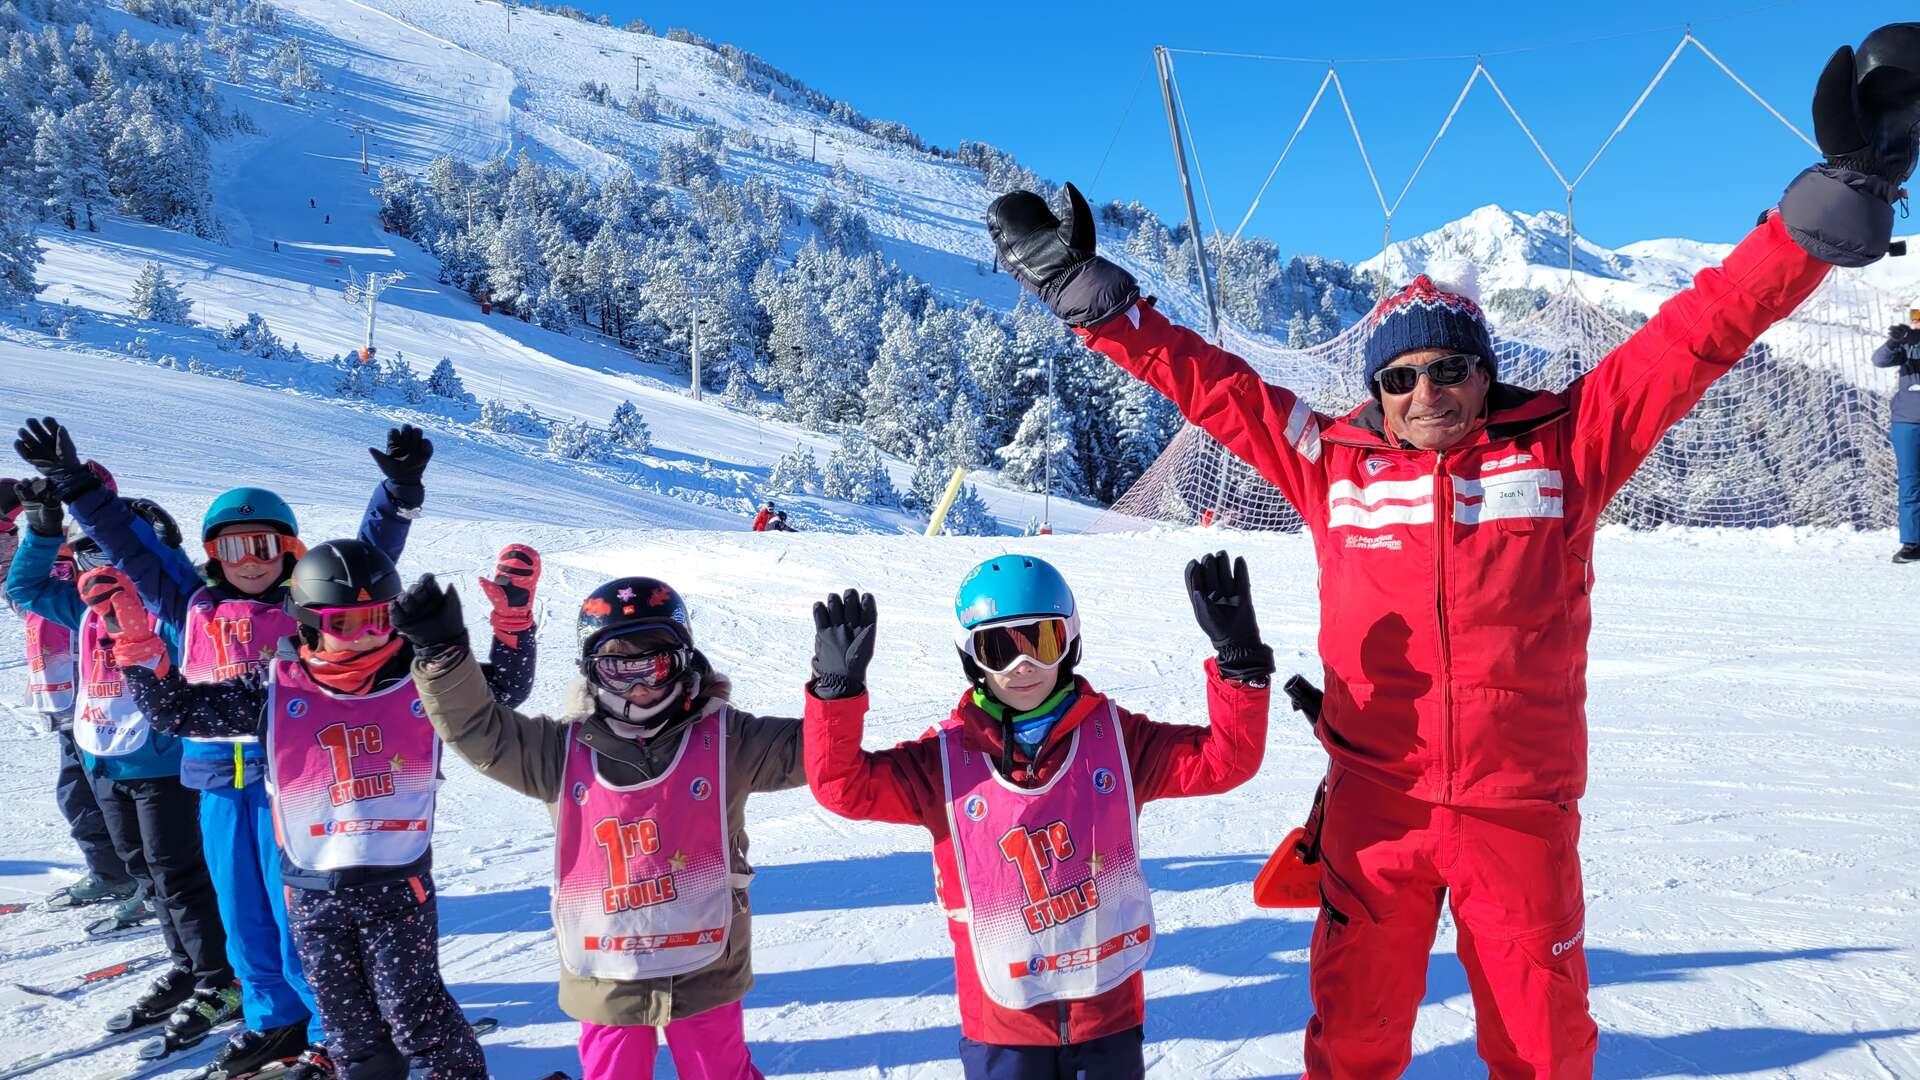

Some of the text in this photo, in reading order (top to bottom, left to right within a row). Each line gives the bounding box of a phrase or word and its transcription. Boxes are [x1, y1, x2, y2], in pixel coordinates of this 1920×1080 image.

[1499, 489, 1524, 498] Jean N
[204, 616, 253, 667] 1re
[315, 722, 384, 785] 1re
[328, 772, 396, 807] ETOILE
[593, 816, 661, 889] 1re
[998, 820, 1075, 904] 1re
[601, 874, 678, 915] ETOILE
[1021, 878, 1100, 934] ETOILE
